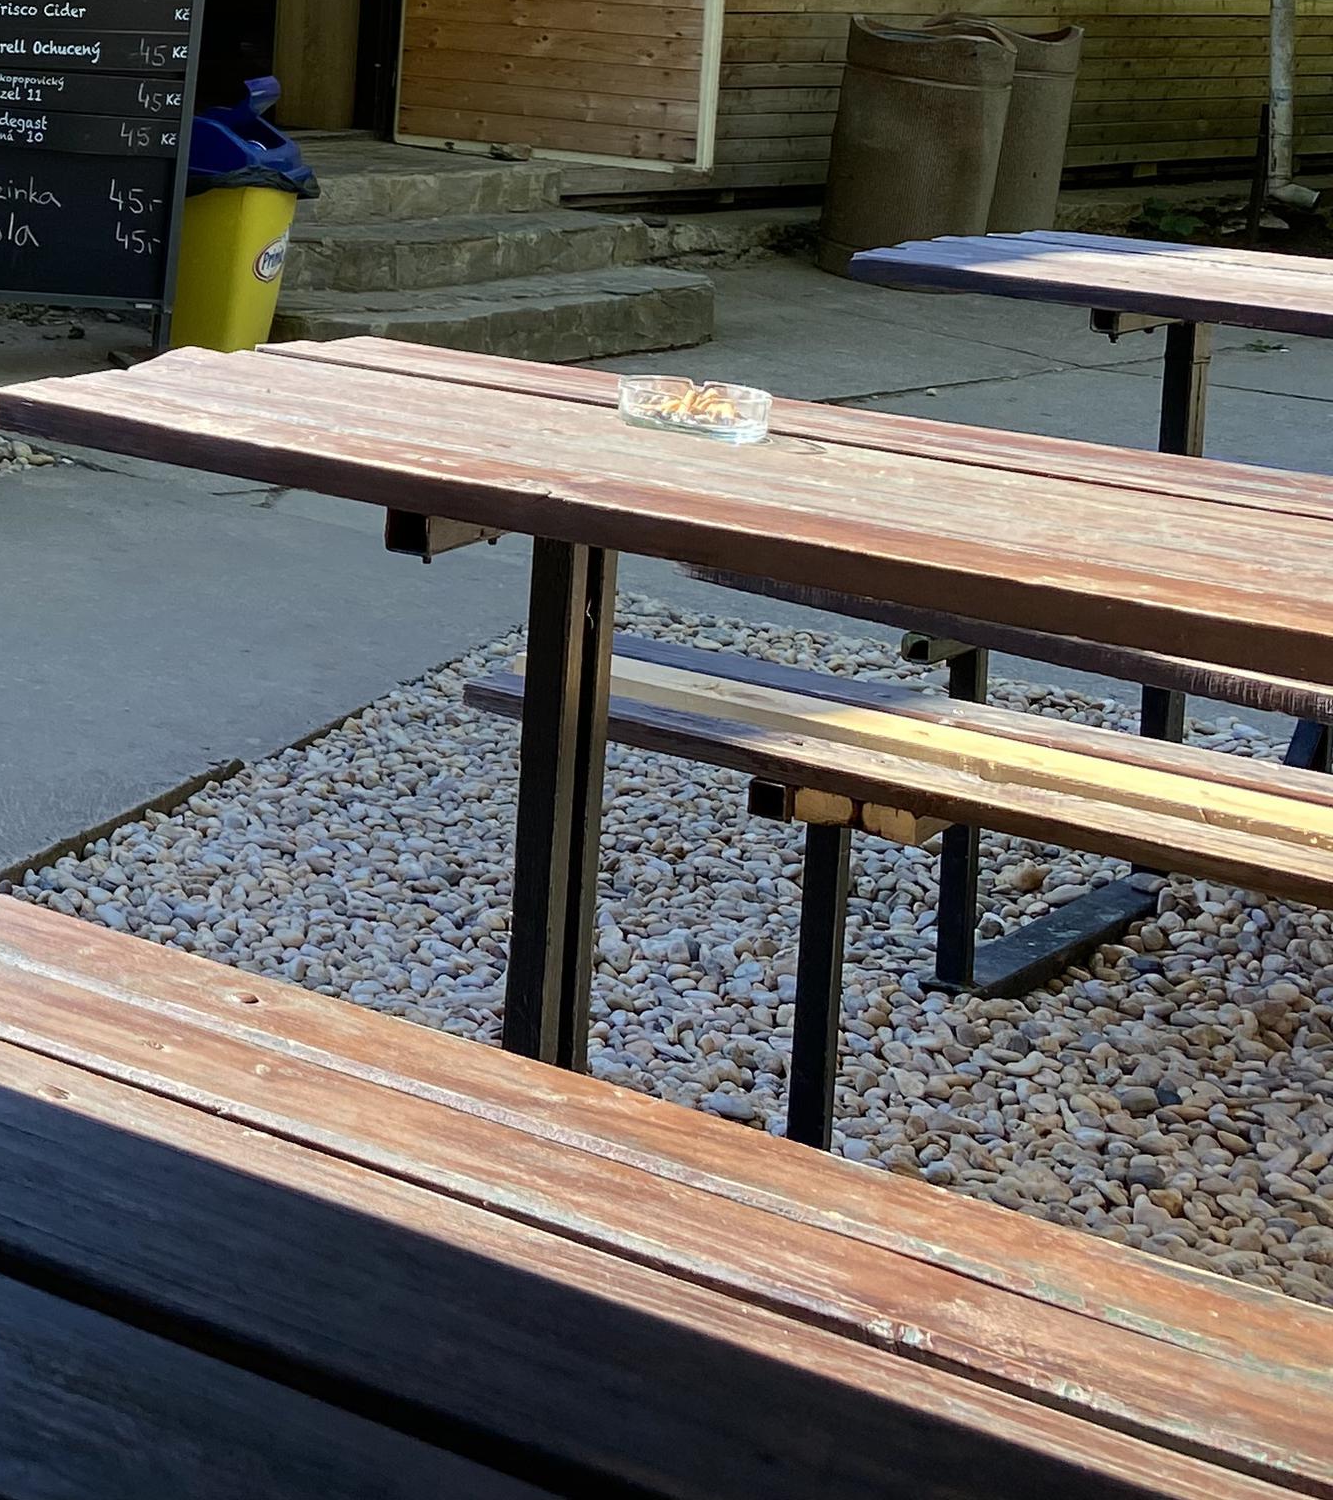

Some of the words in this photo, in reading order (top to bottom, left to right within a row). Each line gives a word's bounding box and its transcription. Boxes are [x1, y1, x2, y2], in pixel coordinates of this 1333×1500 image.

[43, 2, 87, 19] Cider
[175, 7, 190, 22] Kč
[33, 40, 101, 63] Ochucený
[172, 46, 188, 60] Kč
[27, 88, 43, 102] 11
[137, 82, 163, 113] 45
[165, 93, 181, 107] Kč
[26, 129, 44, 143] 10
[120, 121, 152, 147] 45
[161, 132, 178, 146] Kč
